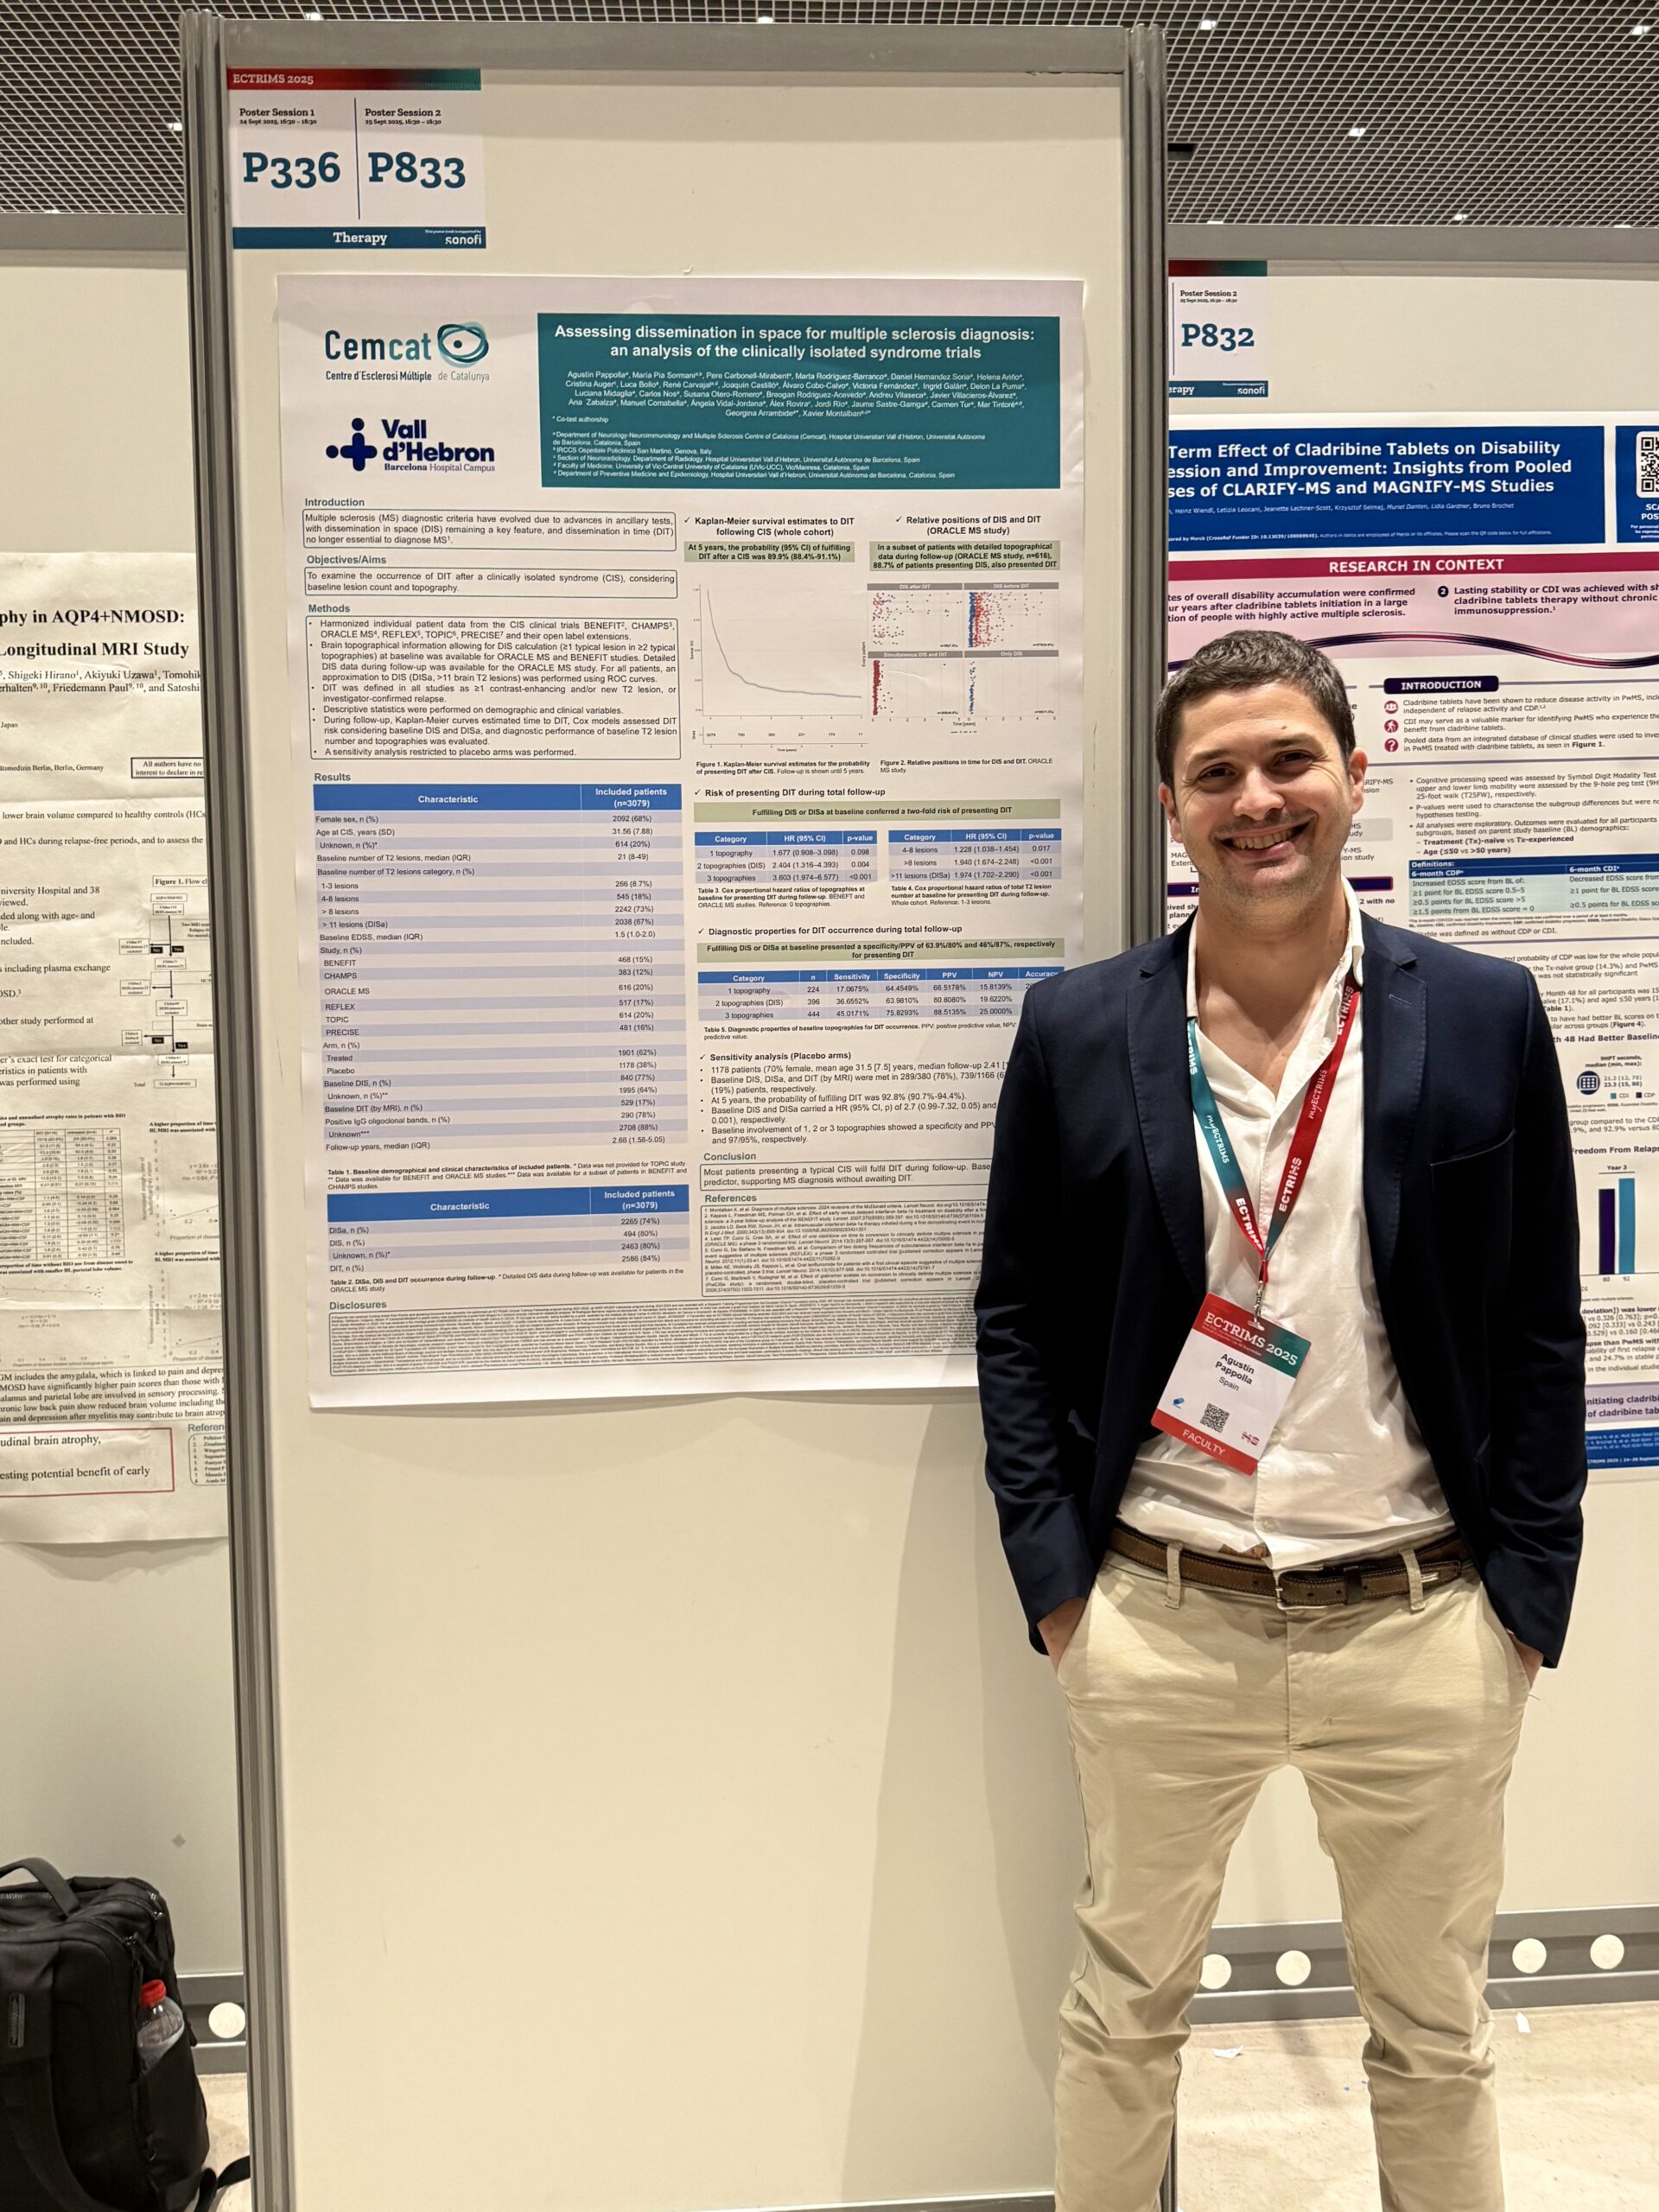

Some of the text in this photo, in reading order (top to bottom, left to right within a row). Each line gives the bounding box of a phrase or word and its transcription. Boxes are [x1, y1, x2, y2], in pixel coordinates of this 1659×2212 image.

[233, 73, 314, 85] ECTRIMS 2025
[242, 151, 340, 188] P336
[368, 151, 465, 188] P833
[333, 232, 387, 245] Therapy
[445, 234, 481, 244] sanofi
[555, 325, 1033, 343] Assessing dissemination in space for multiple sclerosis diagnosis:
[1181, 323, 1254, 351] P832
[325, 330, 431, 359] Cemcat
[610, 344, 981, 360] an analysis of the clinically isolated syndrome trials
[326, 371, 352, 380] Centre
[399, 371, 431, 383] Múltiple
[437, 371, 448, 380] de
[450, 371, 489, 383] Catalunya
[381, 419, 427, 439] Vall
[383, 442, 494, 461] d'Hebron
[1169, 441, 1560, 458] Term Effect of Cladribine Tablets on Disability
[429, 463, 461, 472] Hospital
[463, 464, 494, 473] Campus
[1169, 460, 1571, 479] ession and Improvement: Insights from Pooled
[1169, 479, 1554, 498] ses of CLARIFY-MS and MAGNIFY-MS Studies
[305, 498, 365, 506] Introduction
[695, 517, 750, 525] Kaplan-Meier
[318, 535, 344, 544] longer
[394, 536, 430, 544] diagnose
[716, 528, 754, 537] following
[774, 528, 801, 537] (whole
[804, 529, 833, 537] cohort)
[307, 555, 386, 565] Objectives/Aims
[1329, 558, 1503, 573] RESEARCH IN CONTEXT
[1454, 586, 1488, 594] Lasting
[1491, 586, 1527, 594] stability
[1541, 595, 1578, 604] therapy
[0, 610, 184, 626] phy in AQP4+NMOSD:
[0, 642, 188, 659] ongitudinal MRI Study
[1402, 681, 1481, 690] INTRODUCTION
[315, 772, 351, 781] Results
[634, 788, 667, 797] patients
[613, 799, 650, 808] (n=3079)
[710, 1053, 752, 1062] Sensitivity
[754, 1052, 788, 1061] analysis
[791, 1052, 825, 1061] (Placebo
[1308, 1070, 1327, 1120] myECTRIMS
[1206, 1115, 1230, 1164] myECTRIMS
[703, 1152, 756, 1160] Conclusion
[1279, 1156, 1303, 1212] ECTRIMS
[329, 1301, 386, 1310] Disclosures
[1205, 1312, 1265, 1348] ECTRIMS
[1266, 1343, 1298, 1365] 2025
[1221, 1353, 1255, 1374] Agustín
[1215, 1361, 1252, 1384] Pappolla
[1219, 1376, 1239, 1391] Spain
[1599, 1408, 1643, 1417] cladribine
[34, 1435, 58, 1445] brain
[61, 1434, 100, 1446] atrophy,
[1183, 1429, 1225, 1455] FACULTY
[0, 1465, 149, 1481] esting potential benefit of early
